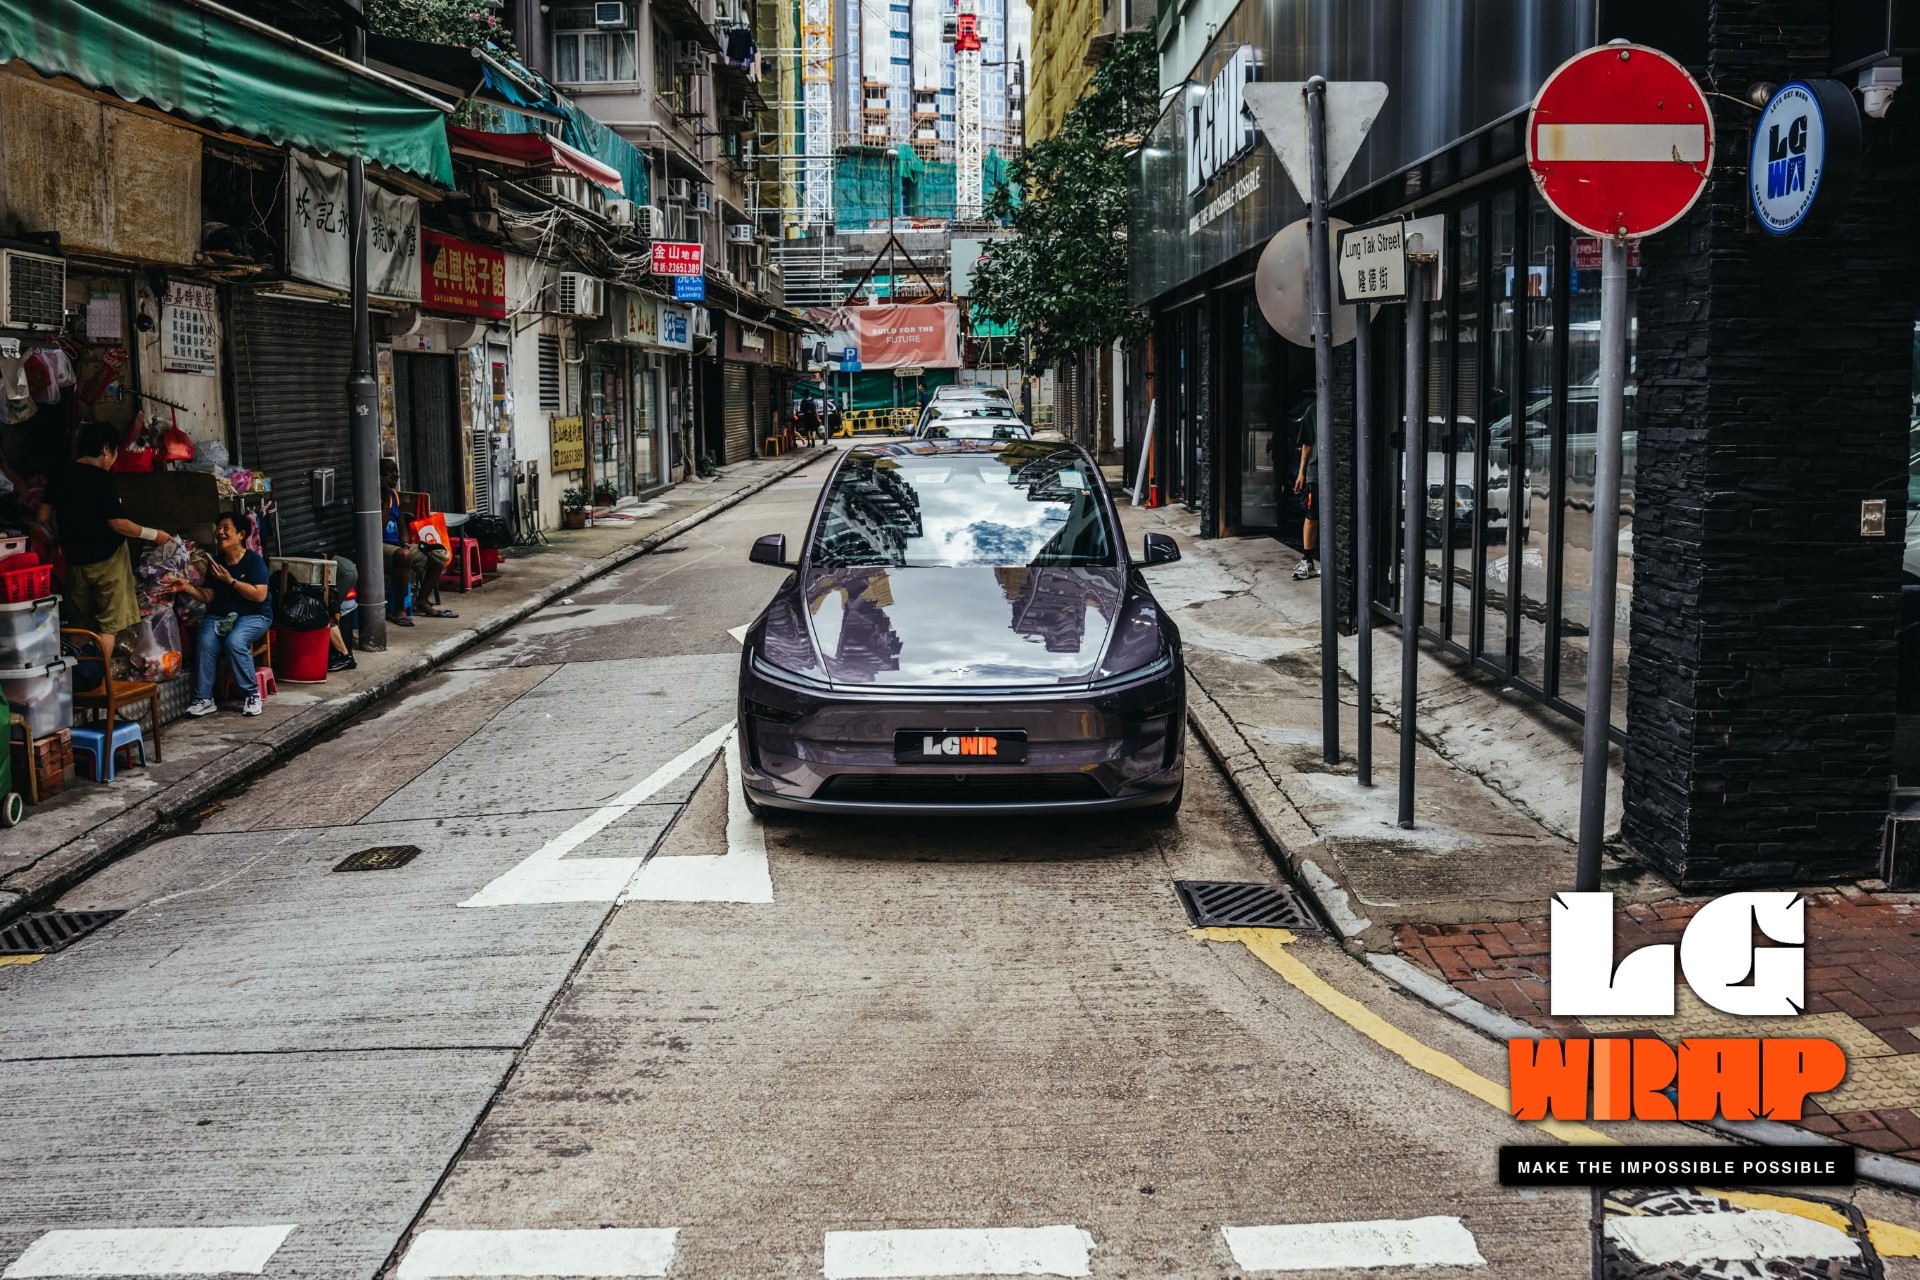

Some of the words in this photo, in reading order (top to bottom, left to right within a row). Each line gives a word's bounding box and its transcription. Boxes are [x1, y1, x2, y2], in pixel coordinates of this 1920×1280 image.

[1783, 90, 1794, 100] GET
[1795, 90, 1809, 103] WASH
[1768, 115, 1808, 163] LG
[1208, 186, 1235, 222] IMPOSSIBLE
[1235, 166, 1260, 203] POSSIBLE
[1754, 184, 1763, 208] MAKE
[1761, 207, 1770, 220] THE
[1769, 212, 1800, 226] IMPOSSIBLE
[1800, 168, 1819, 212] POSSIBLE
[1345, 240, 1361, 260] Lung
[1362, 235, 1376, 255] Tak
[1377, 230, 1401, 252] Street
[872, 328, 897, 336] BUILD
[918, 325, 934, 333] THE
[886, 335, 921, 344] FUTURE
[846, 348, 856, 361] P
[560, 448, 583, 465] 23651389
